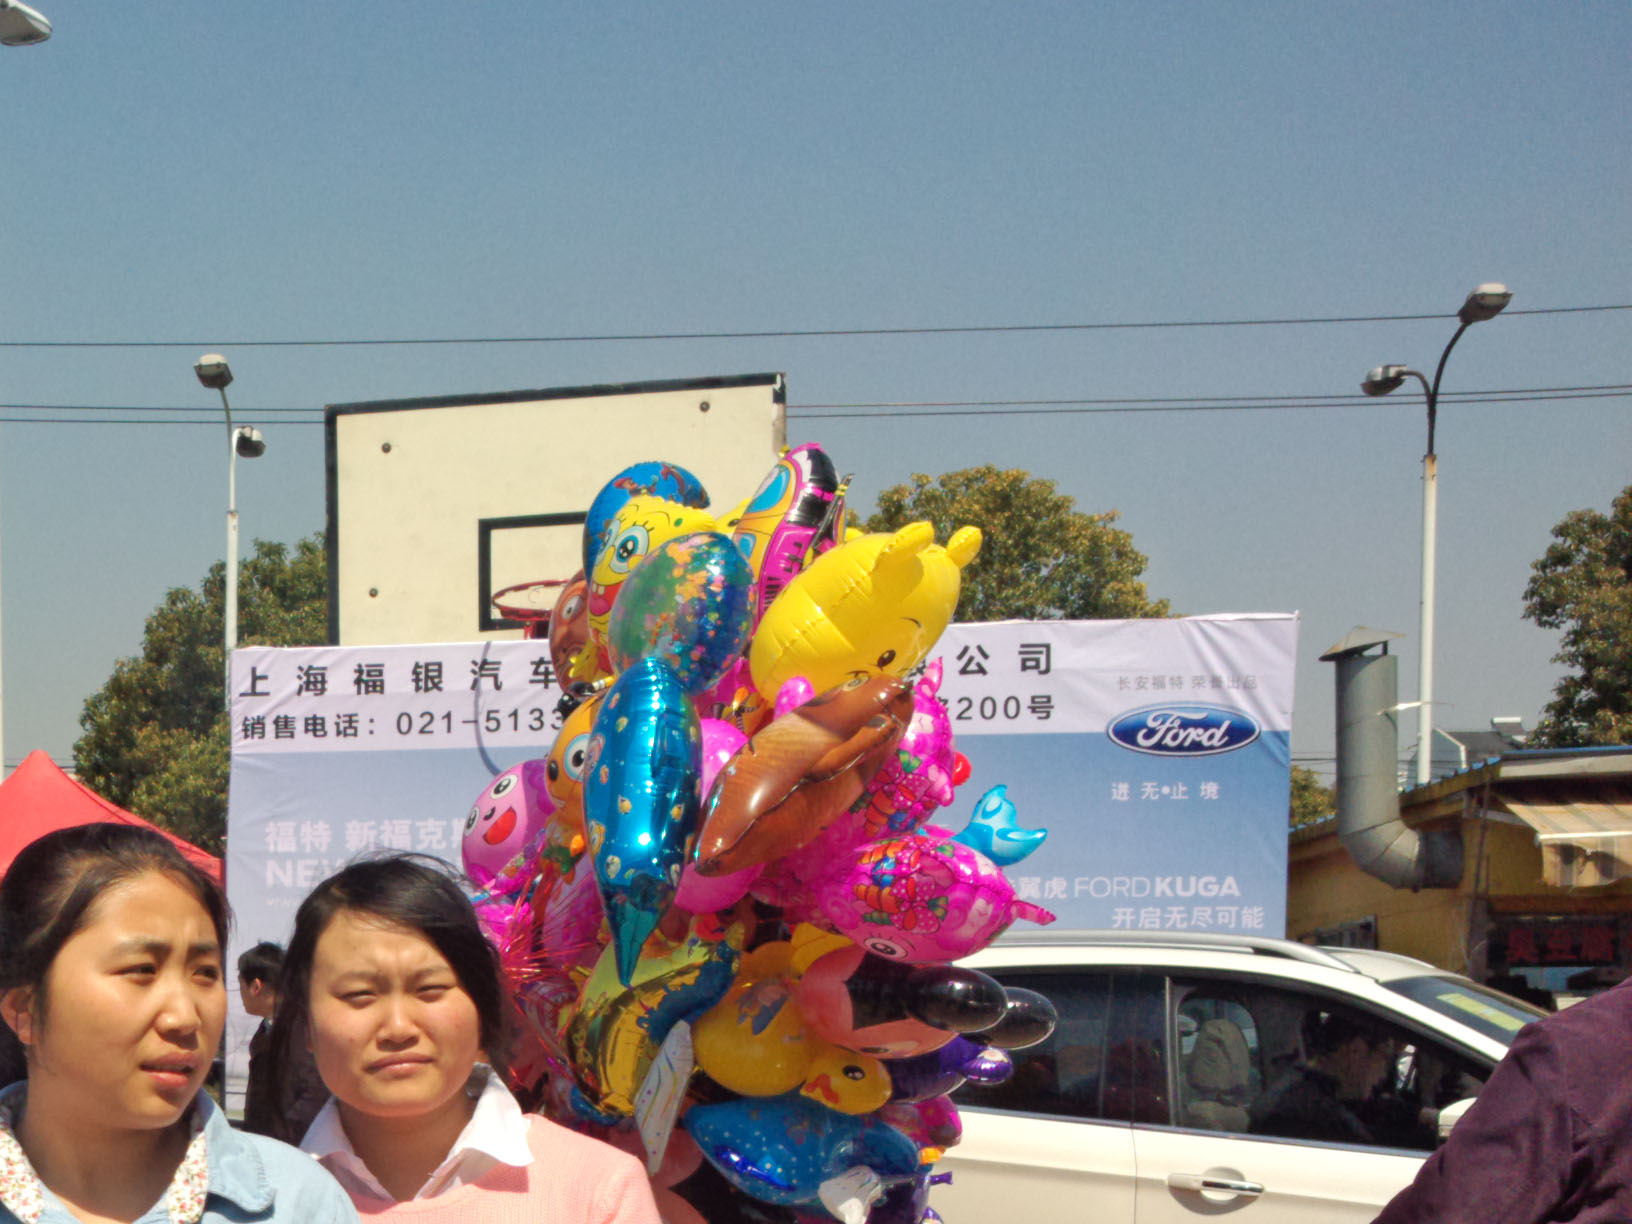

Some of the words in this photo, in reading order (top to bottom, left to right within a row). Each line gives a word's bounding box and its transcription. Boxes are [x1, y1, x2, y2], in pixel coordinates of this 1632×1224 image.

[239, 656, 558, 697] 上海福银汽车
[265, 820, 332, 853] 福特
[1010, 876, 1067, 899] 翼虎
[1074, 876, 1150, 898] FORD
[1156, 875, 1241, 898] KUGA
[1111, 905, 1265, 930] 开启无尽可能
